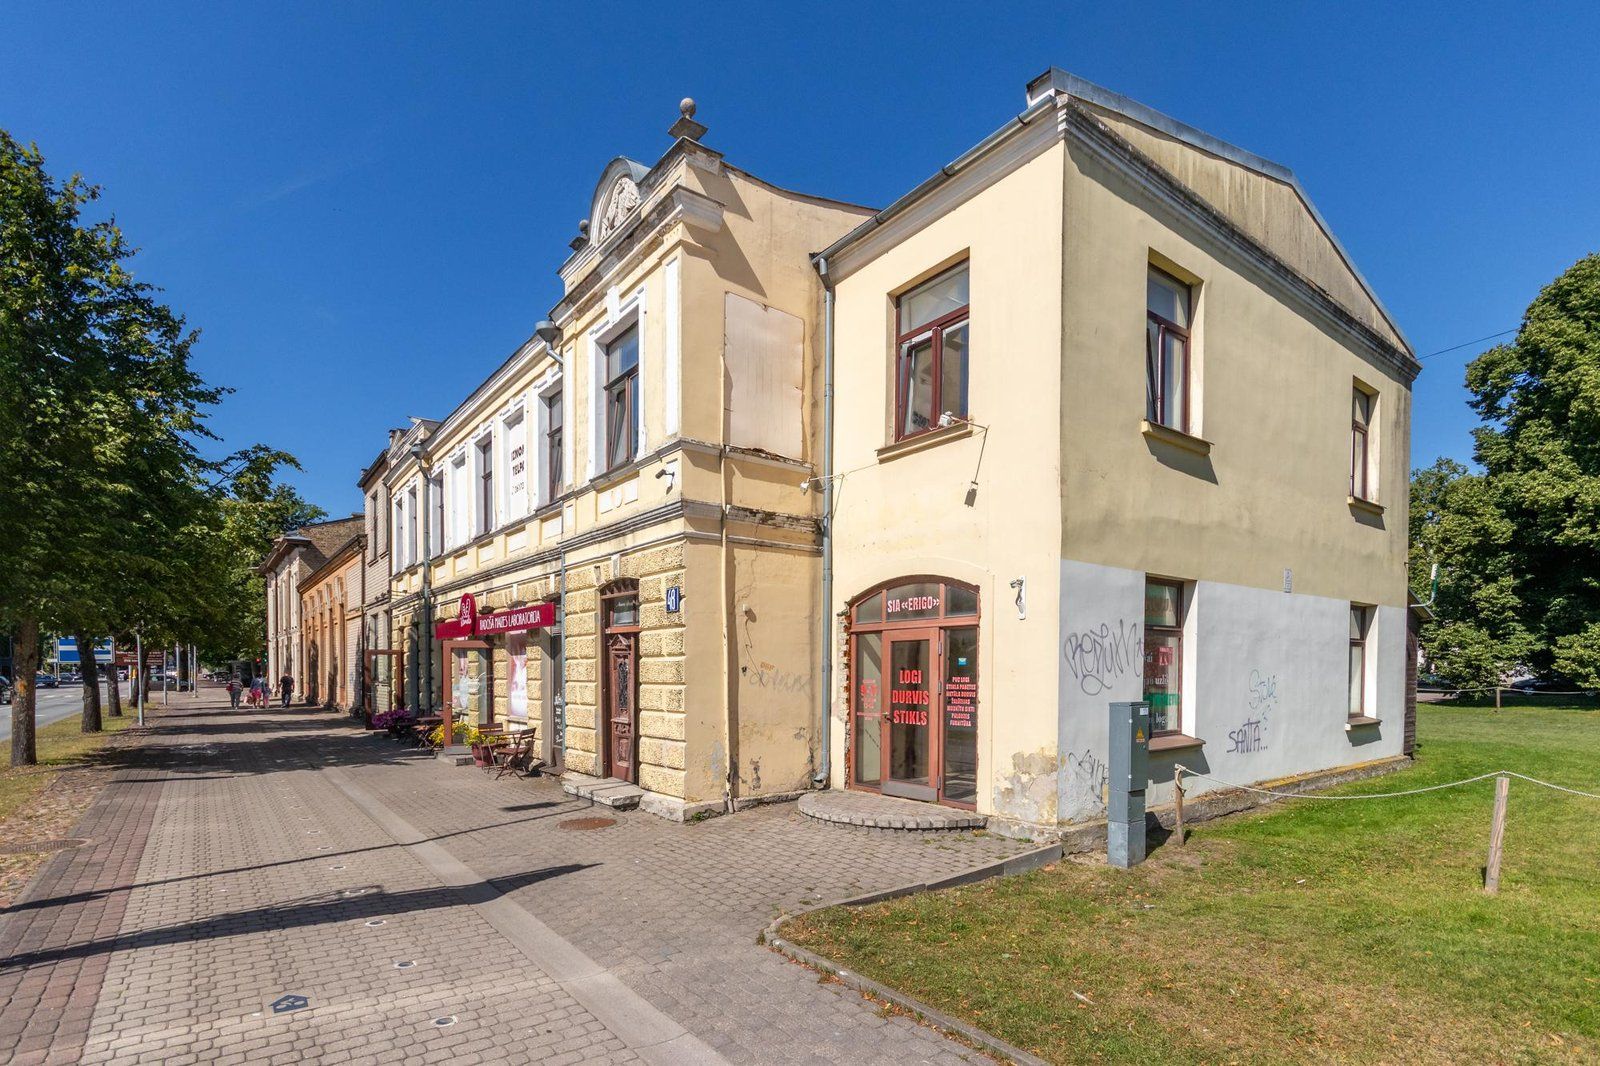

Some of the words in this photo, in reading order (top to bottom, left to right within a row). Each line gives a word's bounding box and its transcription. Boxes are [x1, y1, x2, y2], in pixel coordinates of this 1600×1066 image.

[668, 589, 676, 611] 48
[887, 599, 901, 613] SIA
[899, 670, 922, 684] LOGI
[892, 690, 930, 705] DURVIS
[893, 710, 928, 726] STIKLS
